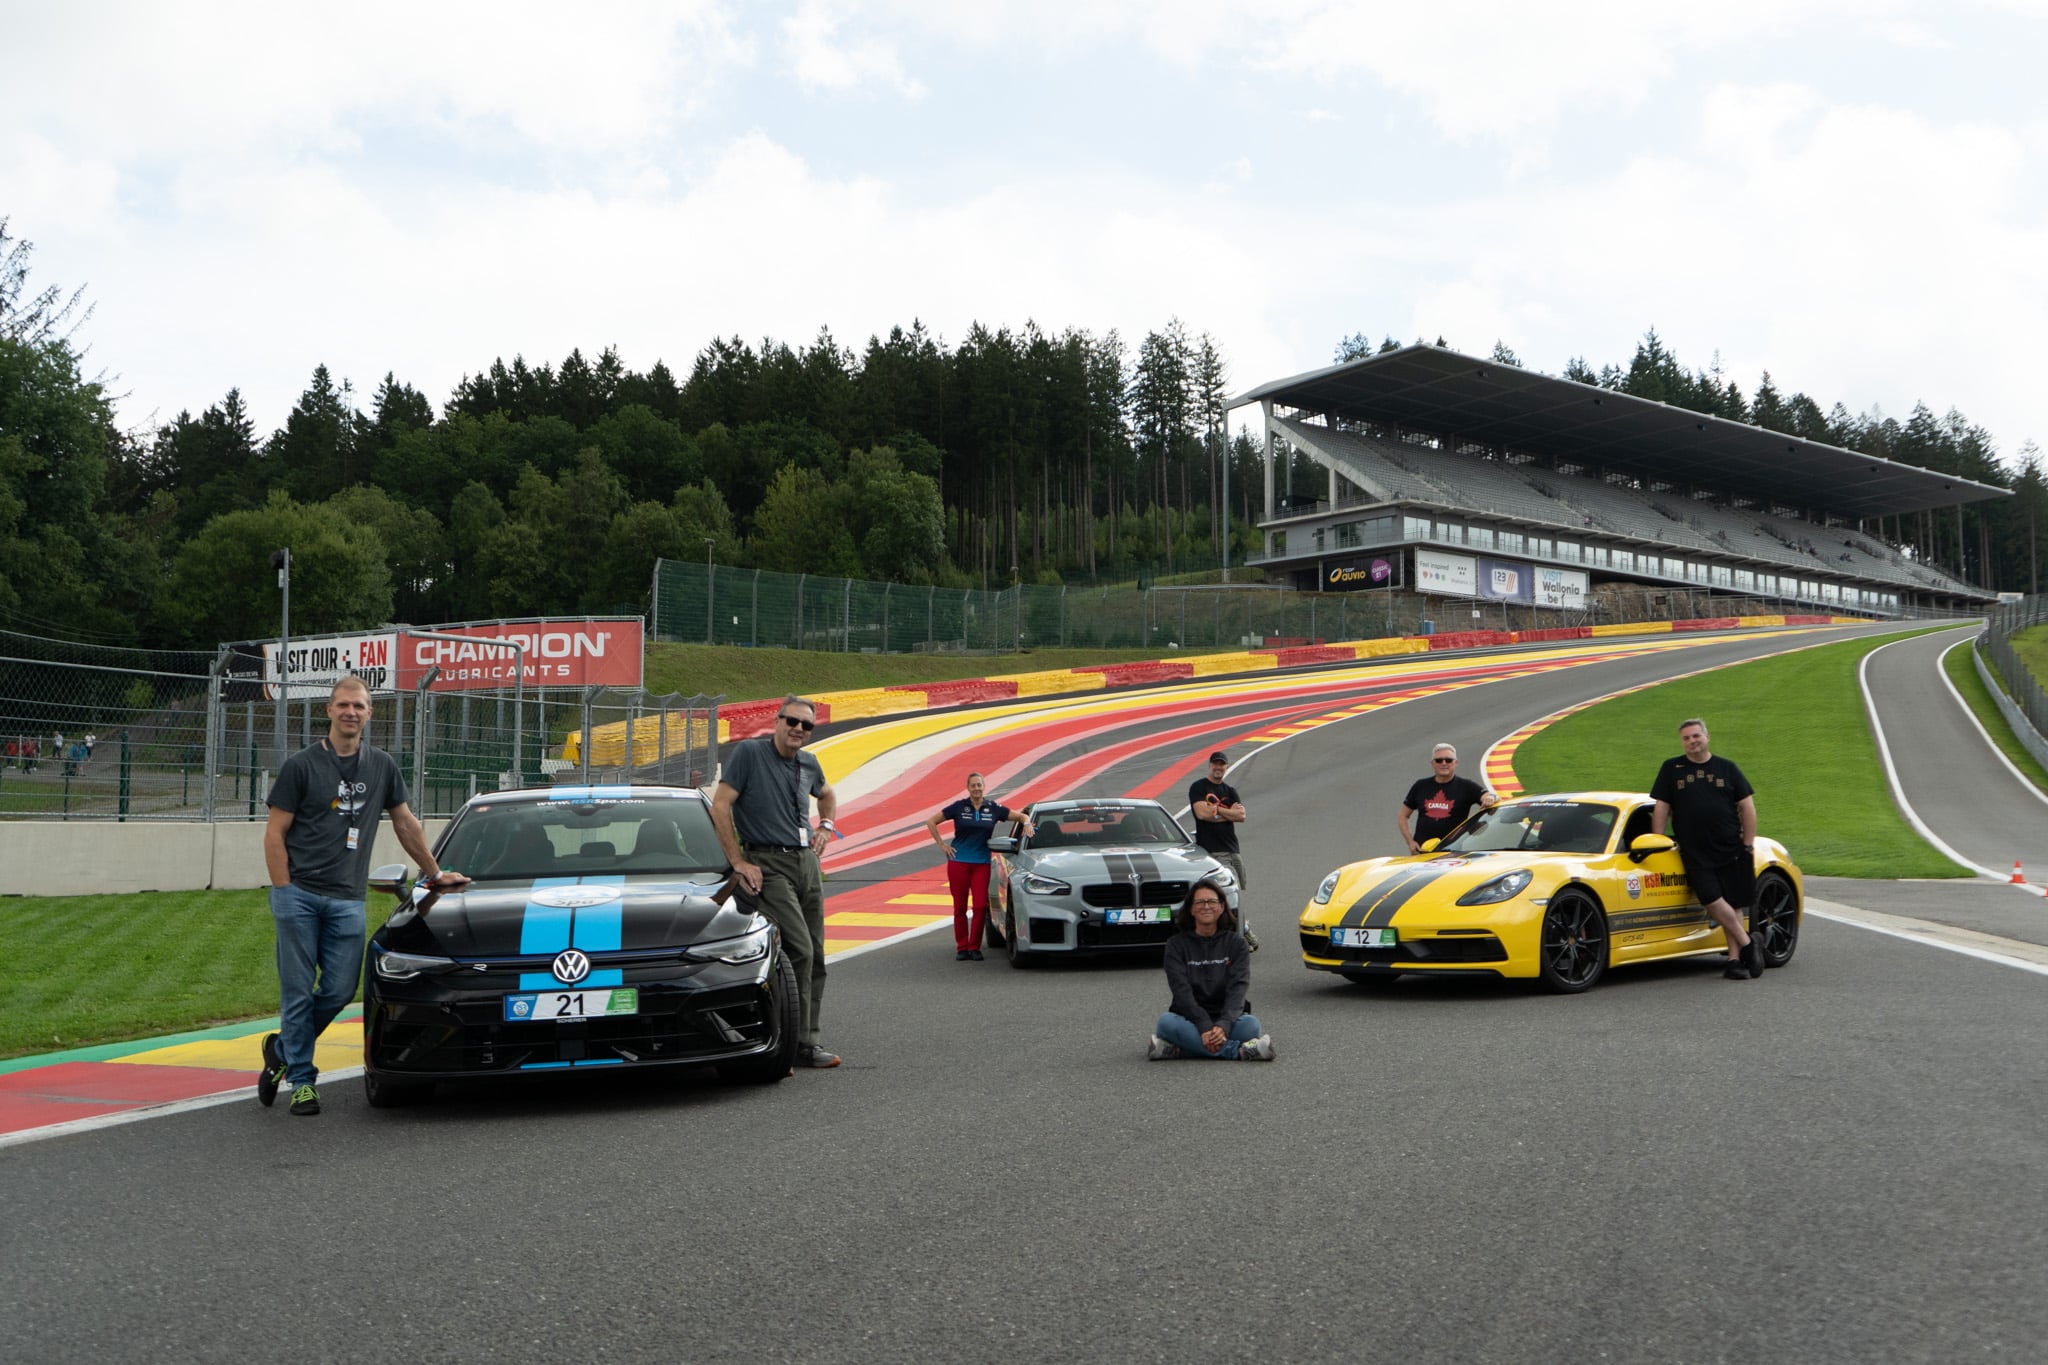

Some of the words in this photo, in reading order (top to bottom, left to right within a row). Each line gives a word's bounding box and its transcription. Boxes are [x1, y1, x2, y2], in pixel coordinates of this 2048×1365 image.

[1494, 571, 1506, 582] 123
[1543, 569, 1563, 581] VISIT
[1543, 581, 1580, 595] Wallonia
[359, 639, 387, 667] FAN
[415, 632, 605, 665] CHAMPION
[275, 649, 308, 674] VSIT
[311, 647, 338, 671] OUR
[1131, 909, 1147, 921] 14
[1355, 930, 1370, 944] 12
[556, 993, 584, 1017] 21
